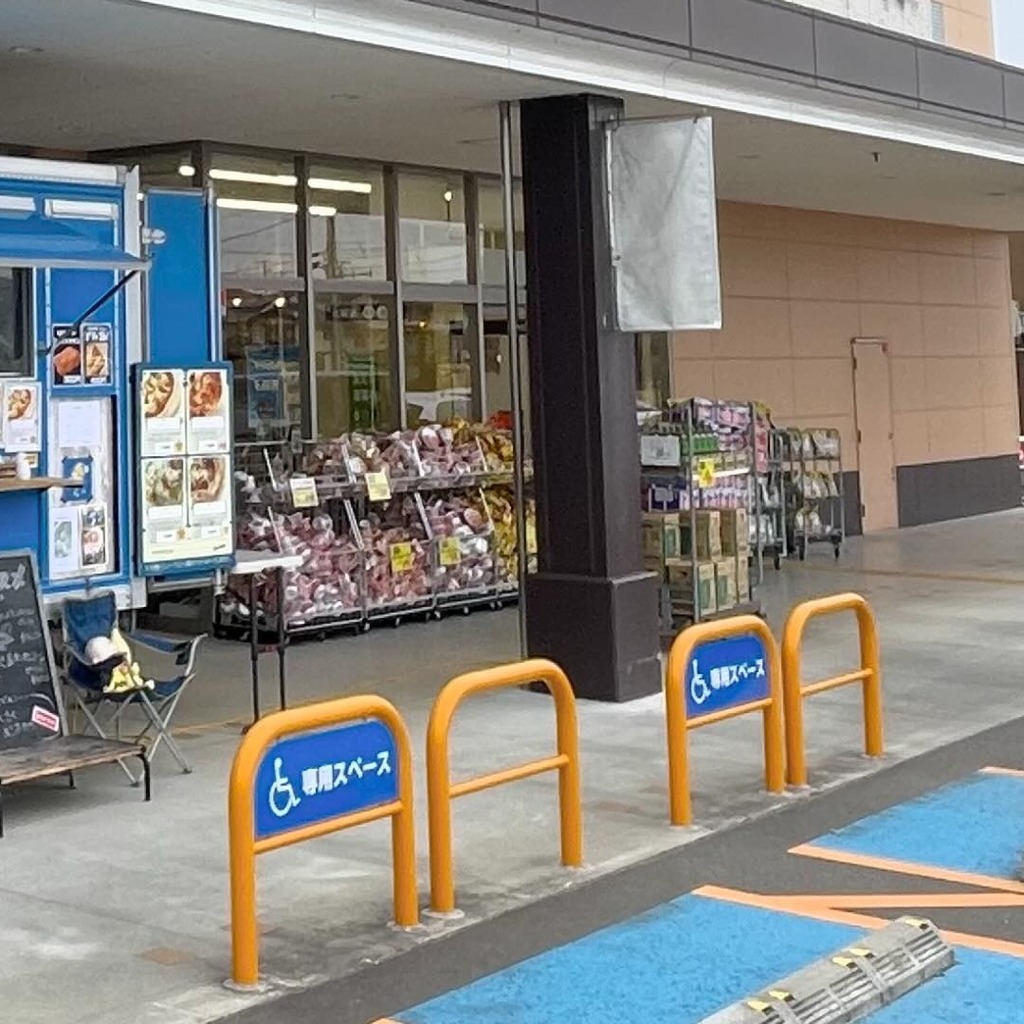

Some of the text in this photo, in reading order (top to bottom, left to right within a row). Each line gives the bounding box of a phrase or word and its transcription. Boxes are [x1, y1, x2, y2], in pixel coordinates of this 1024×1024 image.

[710, 658, 765, 689] 専用スペース
[301, 750, 391, 796] 専用スペース
